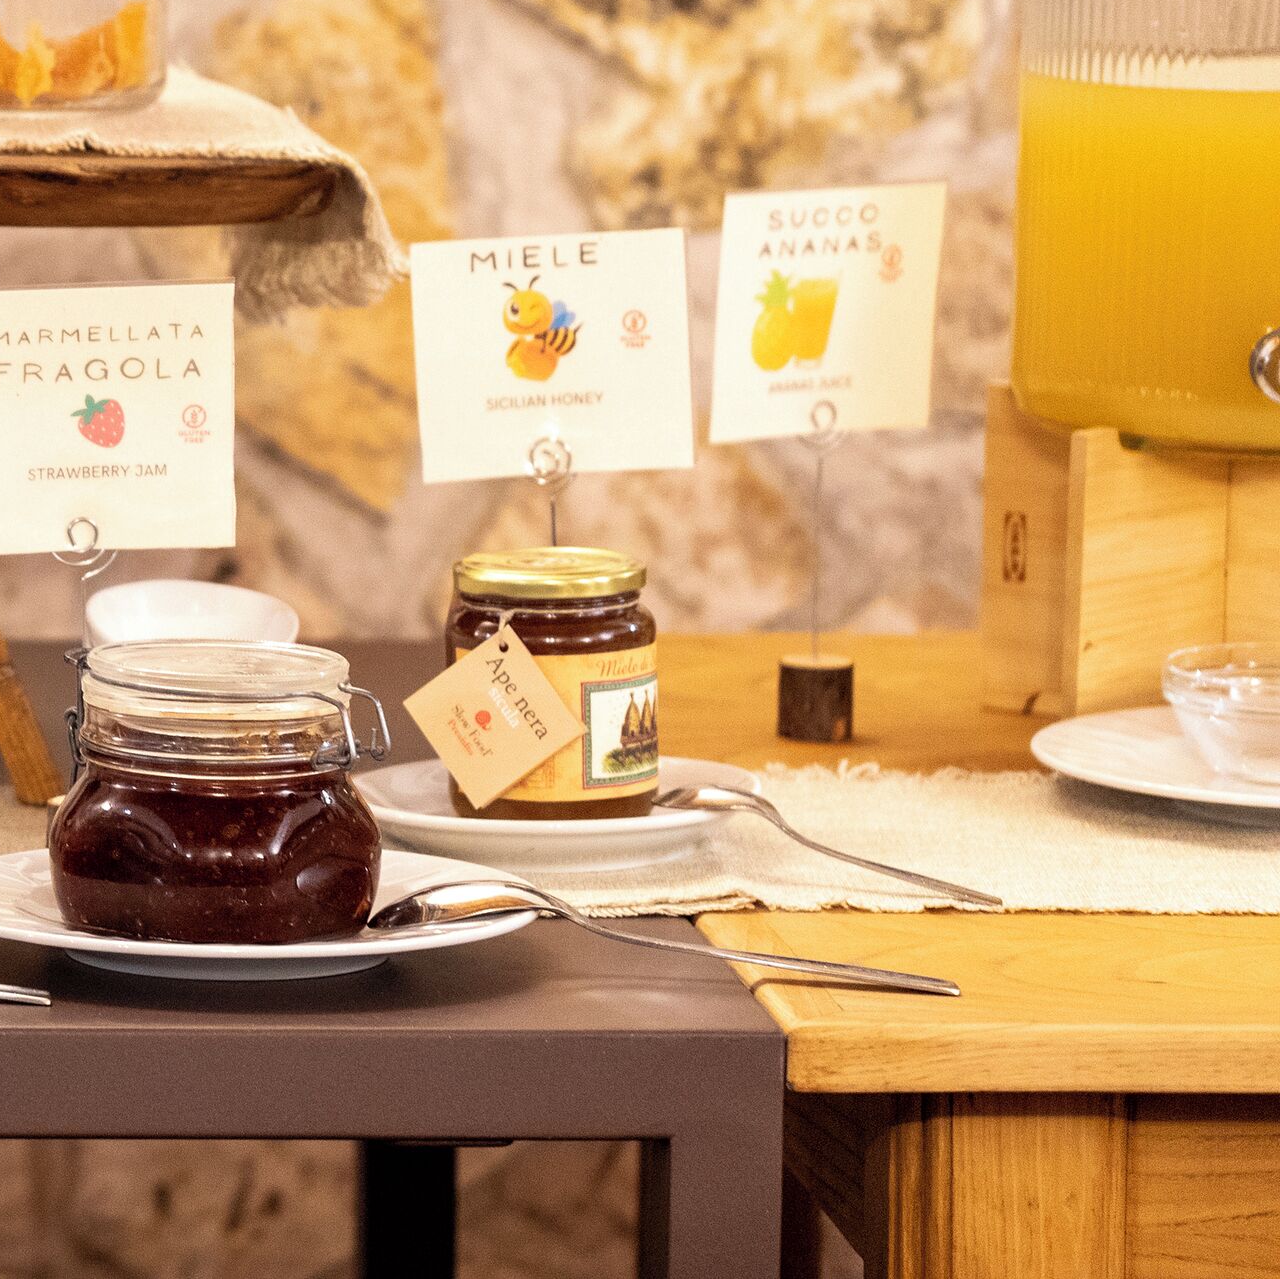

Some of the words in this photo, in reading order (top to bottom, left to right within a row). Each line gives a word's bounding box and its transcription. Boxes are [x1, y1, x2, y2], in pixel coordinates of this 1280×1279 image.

[768, 203, 880, 231] SUCCO
[471, 242, 598, 272] MIELE
[759, 231, 881, 260] ANANAS
[486, 394, 546, 411] SICILIAN
[551, 391, 604, 405] HONEY
[28, 465, 130, 482] STRAWBERRY
[135, 463, 168, 478] JAM
[597, 656, 638, 677] Miele
[486, 658, 517, 694] Ape
[515, 697, 548, 740] nera
[488, 687, 520, 728] sicula
